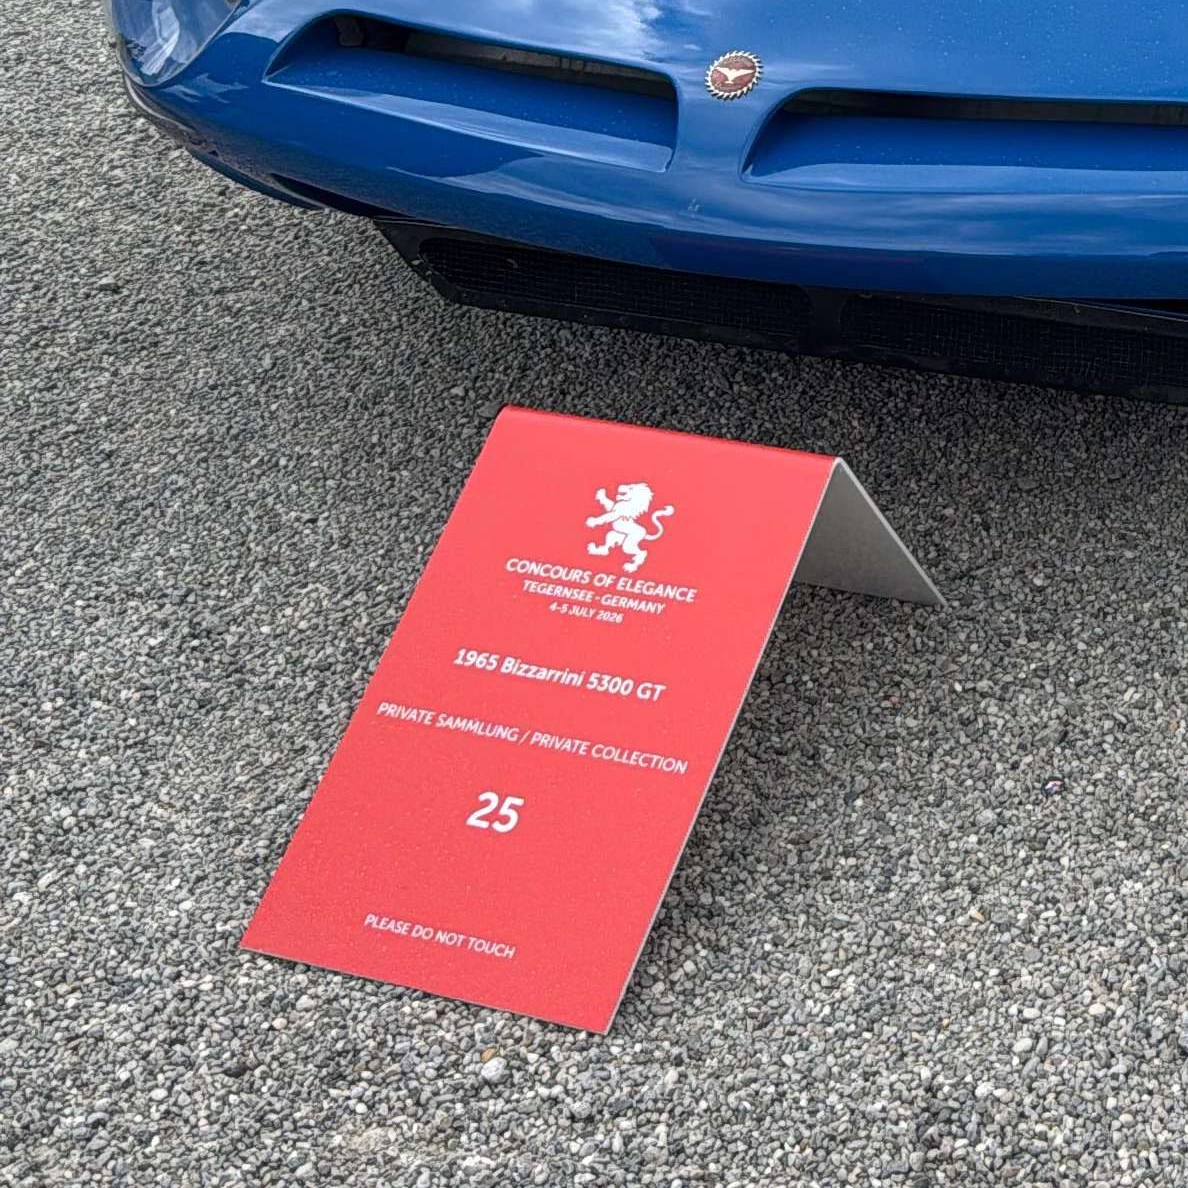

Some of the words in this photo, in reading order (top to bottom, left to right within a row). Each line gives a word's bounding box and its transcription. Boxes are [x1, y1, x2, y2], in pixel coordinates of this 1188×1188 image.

[506, 558, 592, 584] CONCOURS
[593, 573, 616, 588] OF
[616, 576, 698, 603] ELEGANCE
[523, 579, 595, 603] TEGERNSEE
[600, 594, 666, 614] GERMANY
[568, 604, 596, 619] JULY
[596, 609, 624, 624] 2026
[454, 648, 498, 671] 1965
[500, 657, 586, 687] Bizzarrini
[586, 672, 633, 696] 5300
[636, 682, 667, 702] GT
[376, 701, 437, 726] PRIVATE
[437, 714, 520, 743] SAMMLUNG
[529, 731, 591, 756] PRIVATE
[591, 743, 688, 775] COLLECTION
[466, 791, 525, 833] 25
[363, 913, 413, 936] PLEASE
[411, 924, 434, 940] DO
[435, 931, 467, 948] NOT
[467, 937, 516, 960] TOUCH
